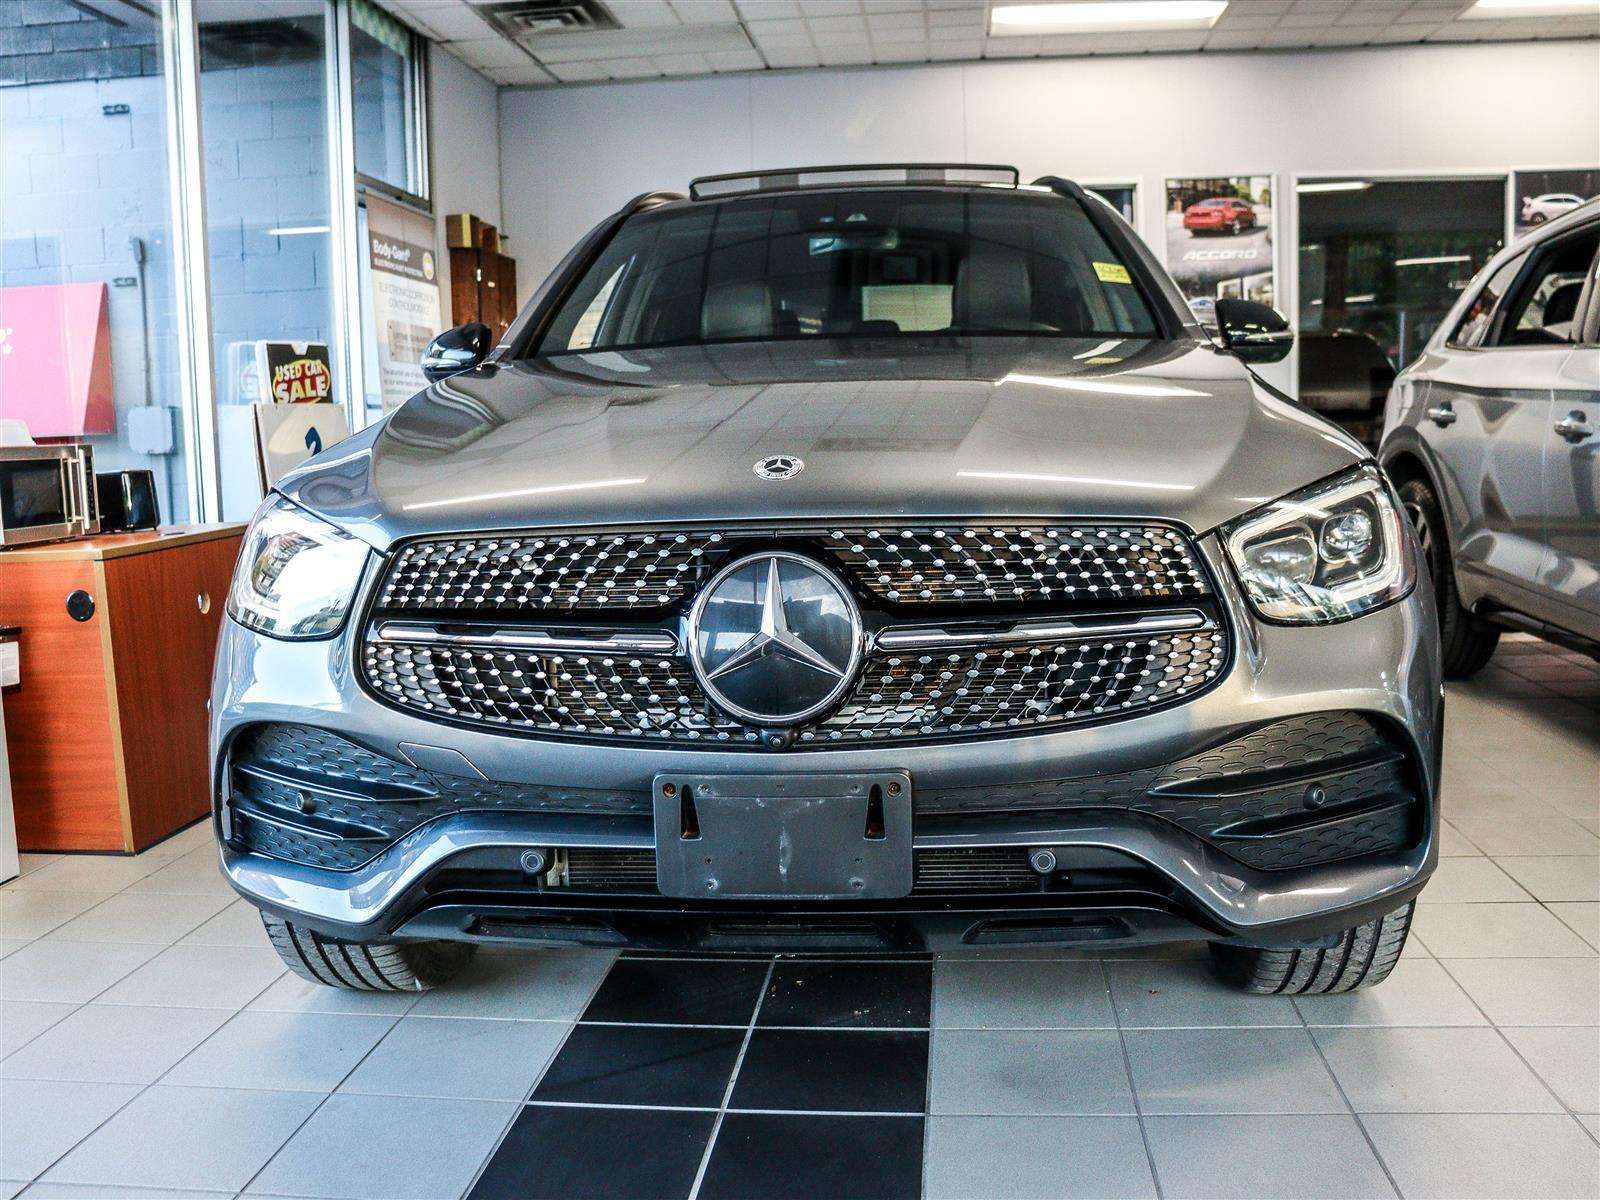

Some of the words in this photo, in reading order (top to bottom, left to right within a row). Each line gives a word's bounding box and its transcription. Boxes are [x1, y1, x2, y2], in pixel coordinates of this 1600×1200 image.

[1183, 250, 1257, 262] ACCORD
[275, 362, 302, 383] USED
[305, 360, 323, 378] CAR
[275, 375, 328, 405] SALE
